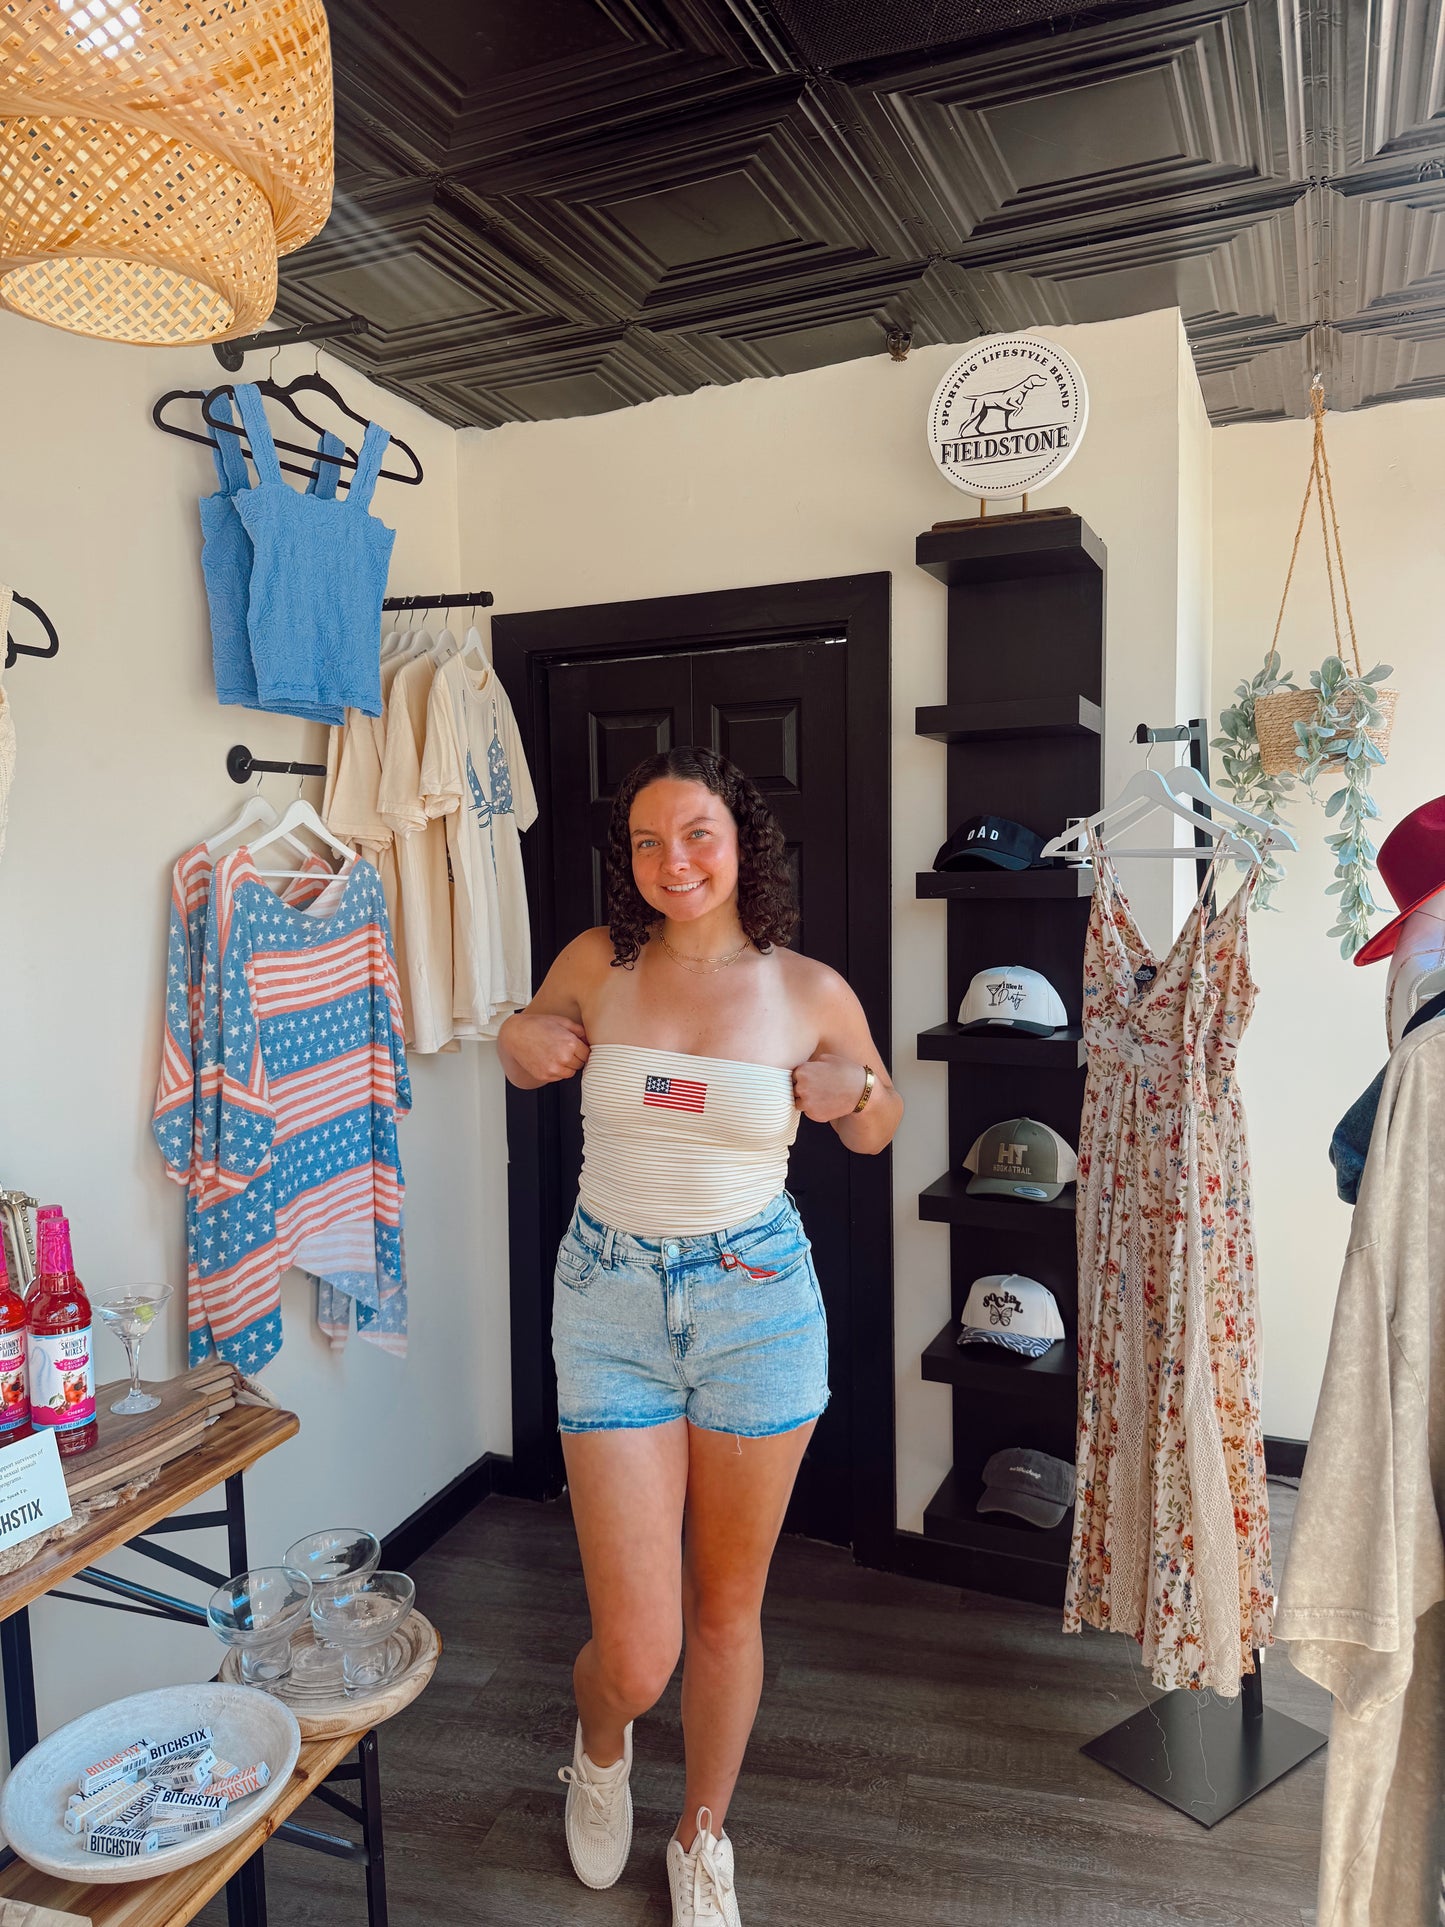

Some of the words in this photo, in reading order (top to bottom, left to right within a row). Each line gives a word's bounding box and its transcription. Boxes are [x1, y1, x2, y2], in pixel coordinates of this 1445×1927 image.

[941, 363, 978, 426] SPORTING
[982, 348, 1049, 367] LIFESTYLE
[1049, 366, 1070, 409] BRAND
[940, 425, 1070, 465] FIELDSTONE
[997, 1142, 1028, 1165] HT
[60, 1338, 83, 1351] SKINNY
[65, 1347, 83, 1357] MIXES
[150, 1728, 207, 1760] BITCHSTIX
[162, 1790, 223, 1809] BITCHSTIX
[93, 1824, 150, 1841] BITCHSTIX
[90, 1834, 141, 1857] BITCHSTIX
